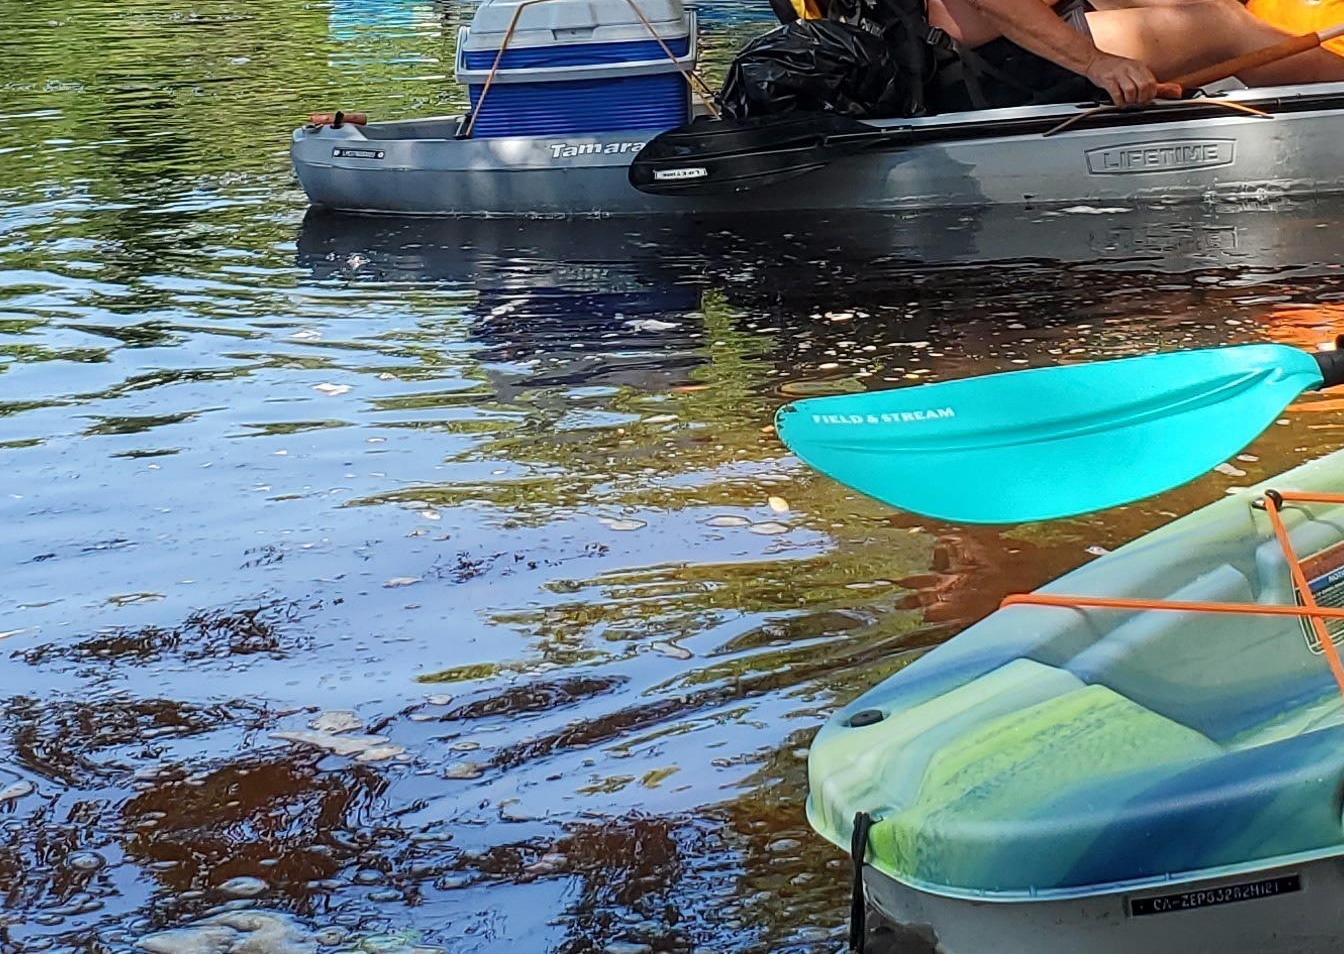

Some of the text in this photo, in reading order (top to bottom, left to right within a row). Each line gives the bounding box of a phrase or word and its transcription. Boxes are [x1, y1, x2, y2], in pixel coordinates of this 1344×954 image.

[1103, 144, 1220, 169] LIFETIME
[812, 407, 955, 425] FIELD & STREAM
